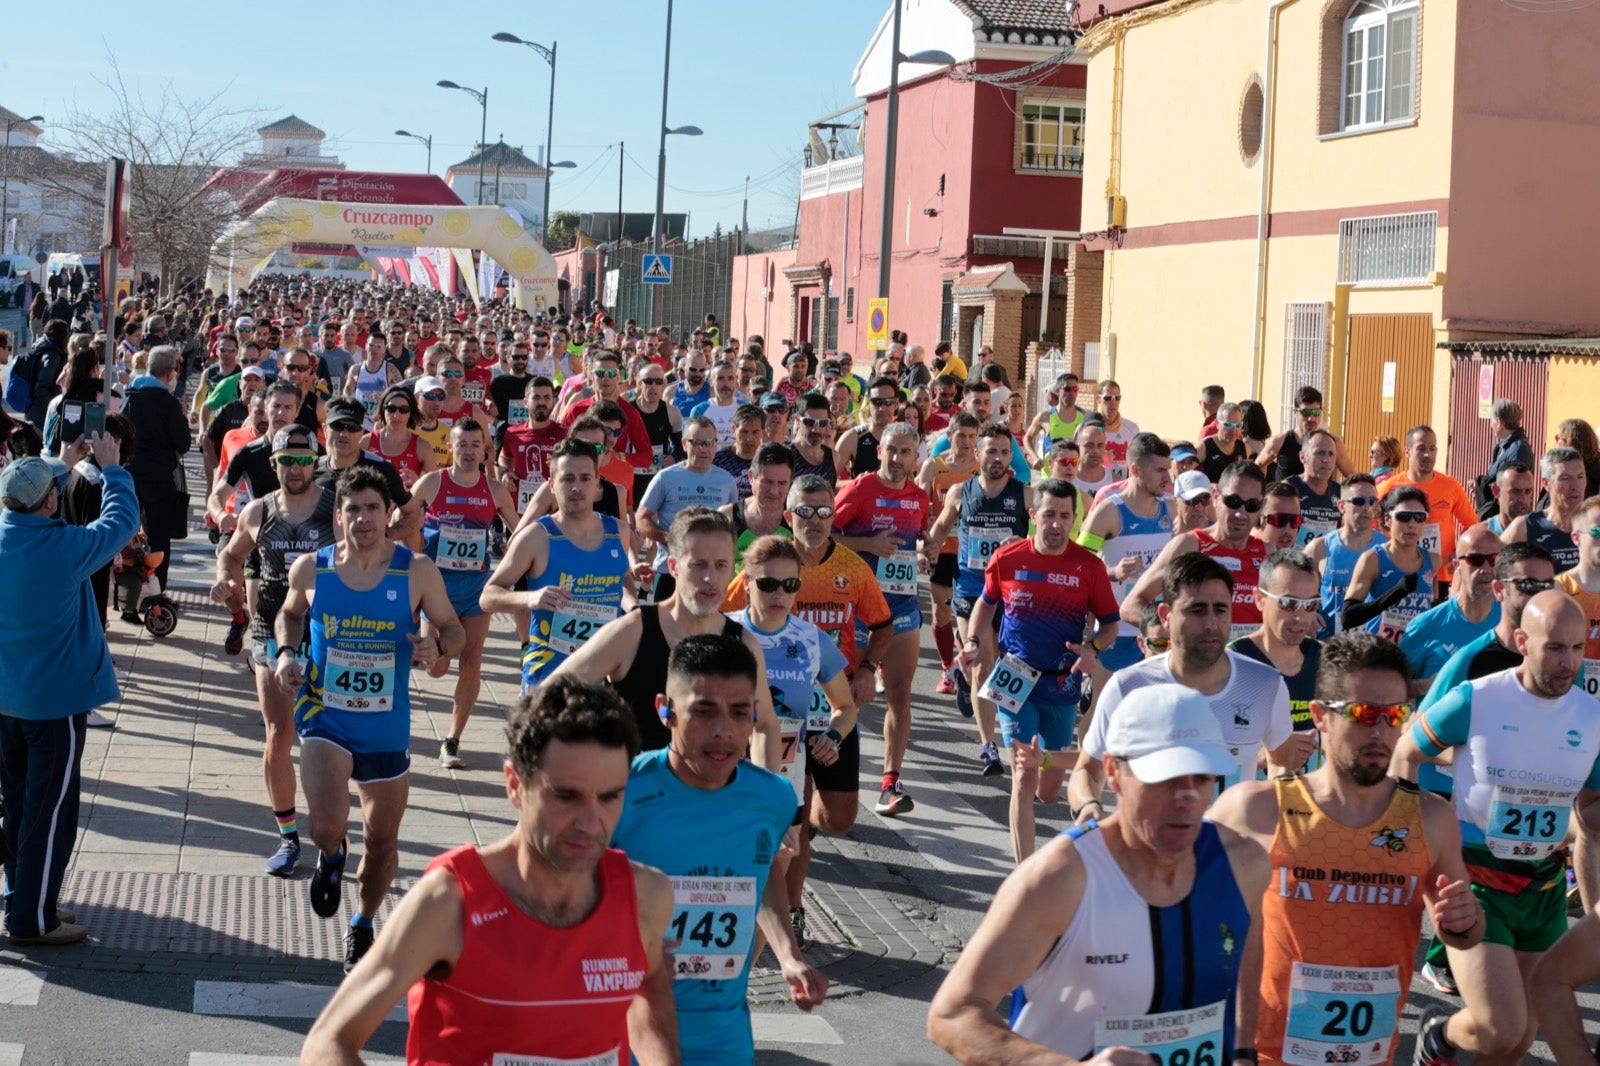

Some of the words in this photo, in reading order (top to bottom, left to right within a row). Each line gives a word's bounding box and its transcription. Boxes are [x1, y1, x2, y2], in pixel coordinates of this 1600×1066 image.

[341, 191, 352, 200] de
[354, 191, 394, 202] Granada
[343, 208, 434, 227] Cruzcampo
[352, 228, 394, 242] Radler
[462, 390, 483, 399] 3213
[468, 497, 488, 506] SEUR
[900, 500, 920, 510] SEUR
[447, 541, 478, 558] 702
[885, 562, 913, 580] 950
[1047, 573, 1080, 588] SEUR
[796, 601, 846, 610] Deportivo
[342, 615, 396, 632] olimpo
[340, 630, 374, 638] deportes
[364, 642, 396, 650] RUNNING
[335, 670, 384, 693] 459
[766, 669, 806, 682] SUMA
[1486, 766, 1505, 777] SIC
[1502, 808, 1556, 838] 213
[1293, 866, 1325, 880] Club
[1331, 869, 1406, 885] Deportivo
[682, 881, 699, 890] GRAN
[702, 882, 723, 891] PREMIO
[724, 882, 731, 891] DE
[672, 912, 737, 948] 143
[582, 958, 628, 972] RUNNING
[1323, 970, 1342, 980] GRAN
[1344, 972, 1370, 980] PREMIO
[1372, 972, 1379, 980] DE
[1132, 1019, 1154, 1030] GRAN
[1157, 1015, 1184, 1027] PREMIO
[1187, 1014, 1195, 1024] DE
[1321, 1000, 1374, 1036] 20
